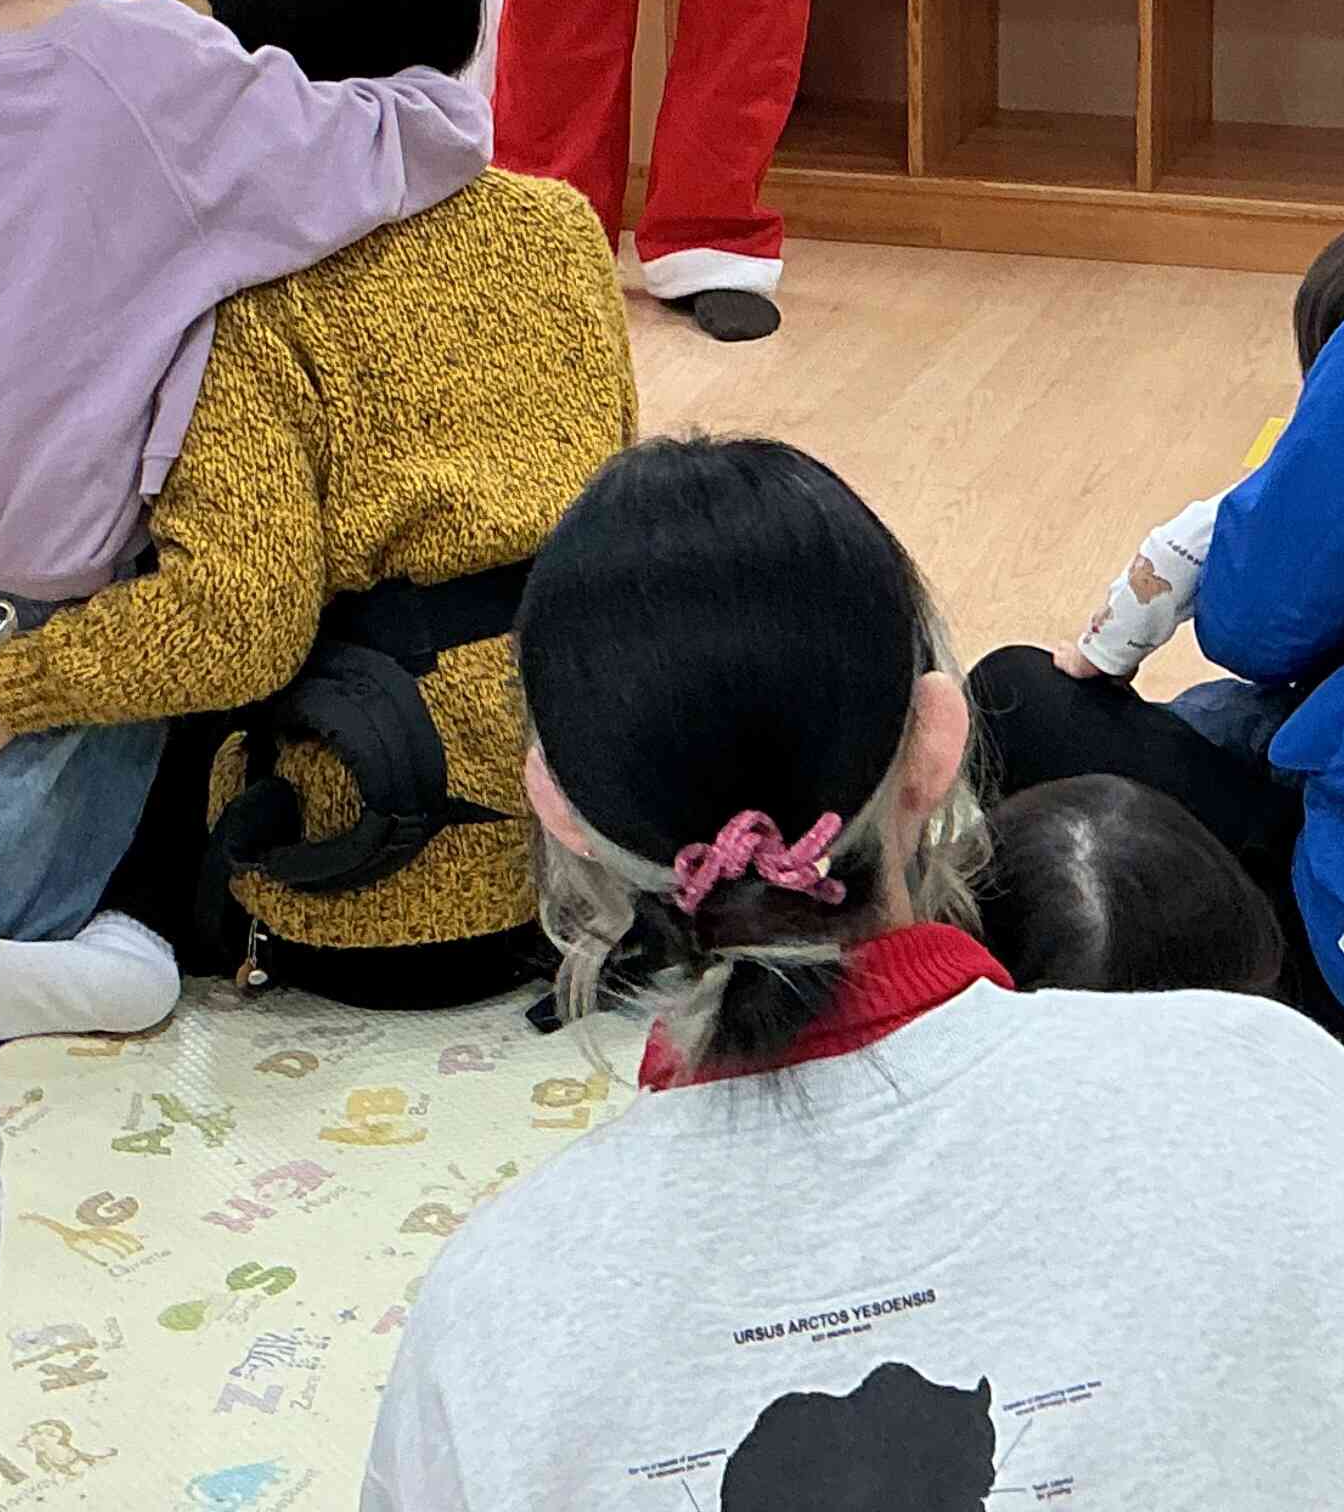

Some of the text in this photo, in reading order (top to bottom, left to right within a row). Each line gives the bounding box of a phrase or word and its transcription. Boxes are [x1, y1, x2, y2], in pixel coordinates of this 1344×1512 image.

[733, 1323, 785, 1345] URSUS
[788, 1309, 850, 1335] ARCTOS
[851, 1289, 937, 1321] YESOENSIS
